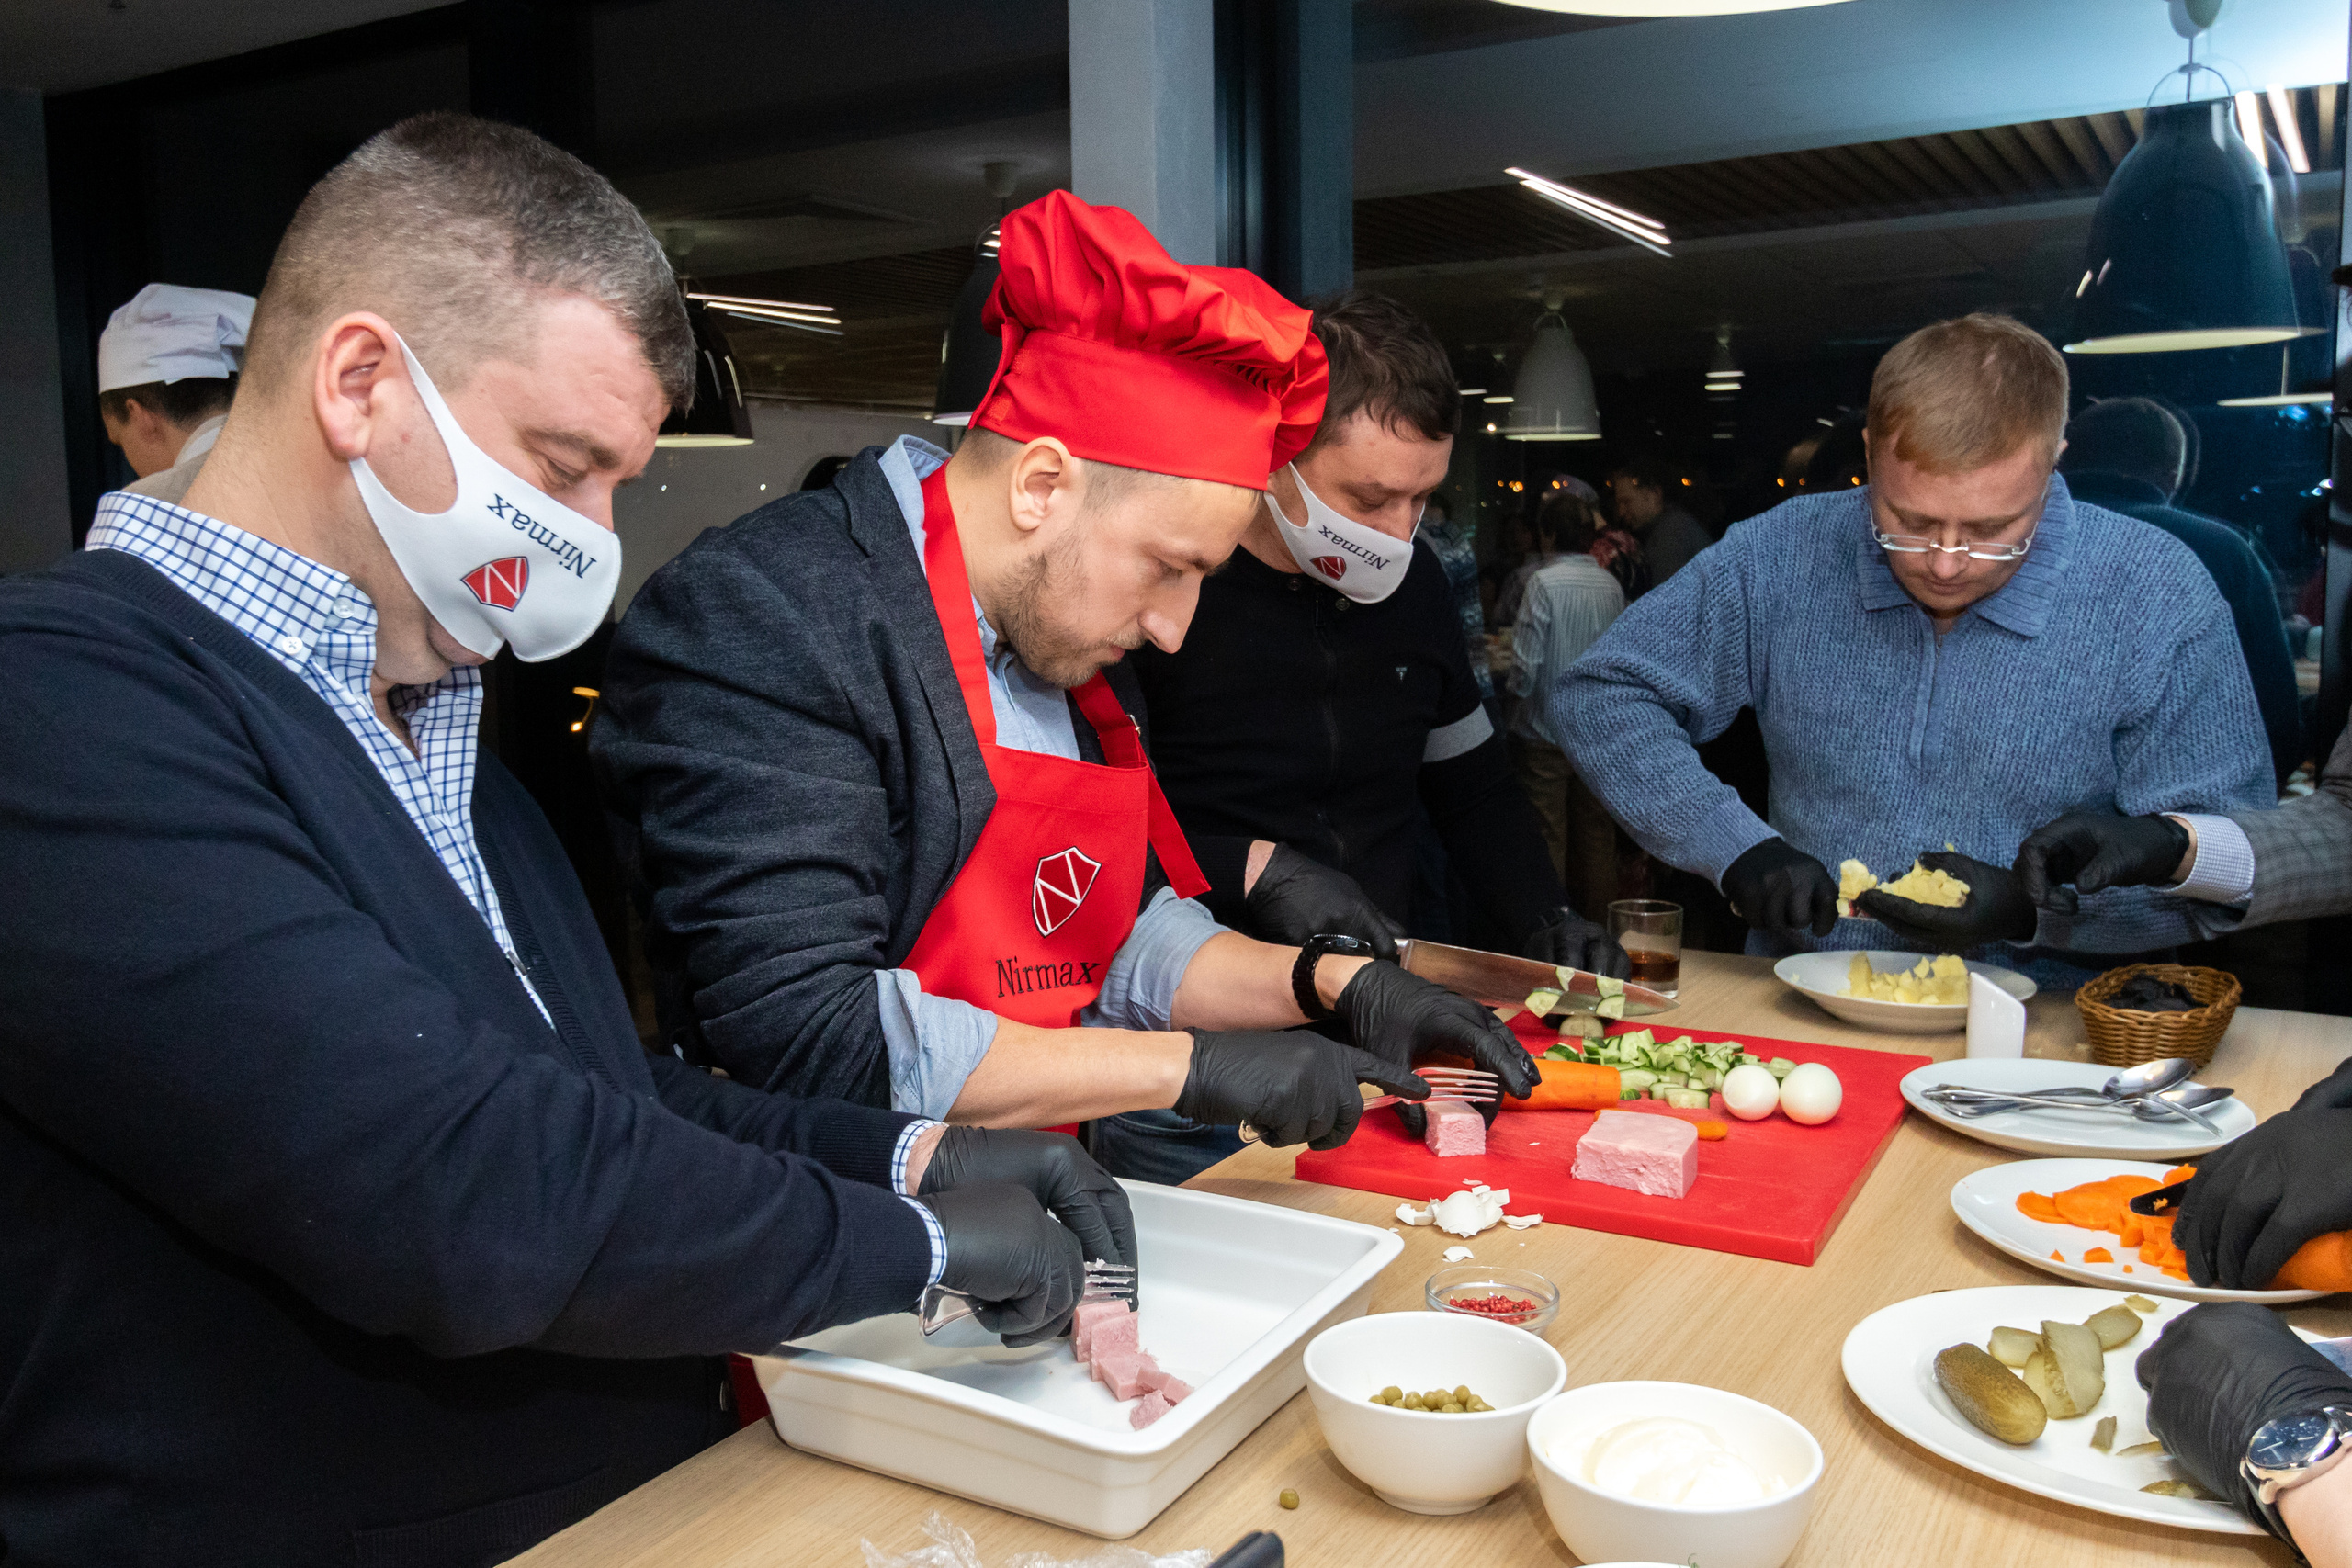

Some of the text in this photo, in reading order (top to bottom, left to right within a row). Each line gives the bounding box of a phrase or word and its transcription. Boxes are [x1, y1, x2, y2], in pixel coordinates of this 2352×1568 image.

[487, 493, 597, 579] Nirmax
[1318, 525, 1390, 570] Nirmax
[996, 955, 1101, 998] Nirmax
